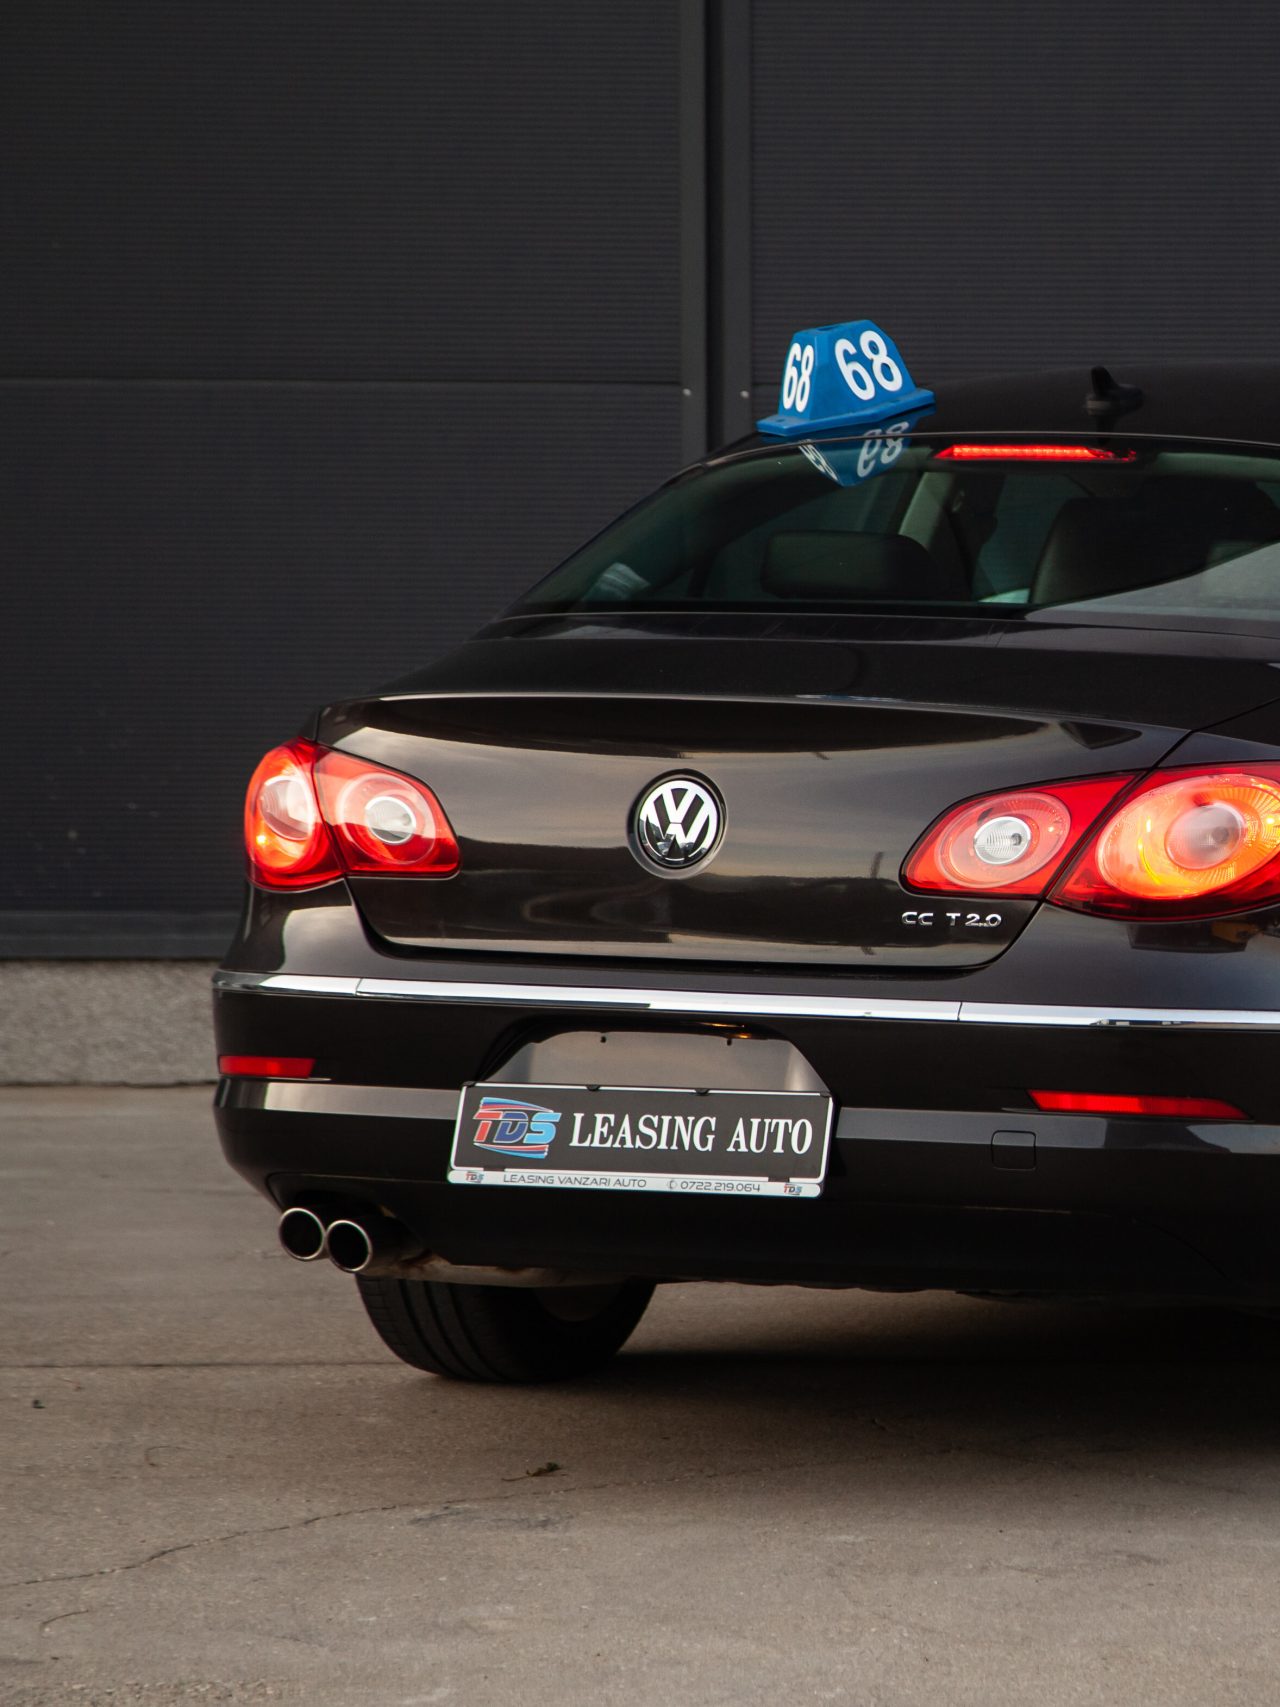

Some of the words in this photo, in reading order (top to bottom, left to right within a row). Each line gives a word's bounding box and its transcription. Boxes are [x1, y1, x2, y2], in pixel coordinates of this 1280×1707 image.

[782, 342, 815, 413] 68
[835, 330, 903, 401] 68
[901, 911, 934, 926] CC
[472, 1109, 562, 1145] TDS
[568, 1112, 717, 1152] LEASING
[725, 1117, 814, 1155] AUTO
[503, 1173, 554, 1185] LEASING
[558, 1175, 611, 1187] VANZARI
[613, 1177, 648, 1188] AUTO
[680, 1180, 761, 1193] 0722.219.064
